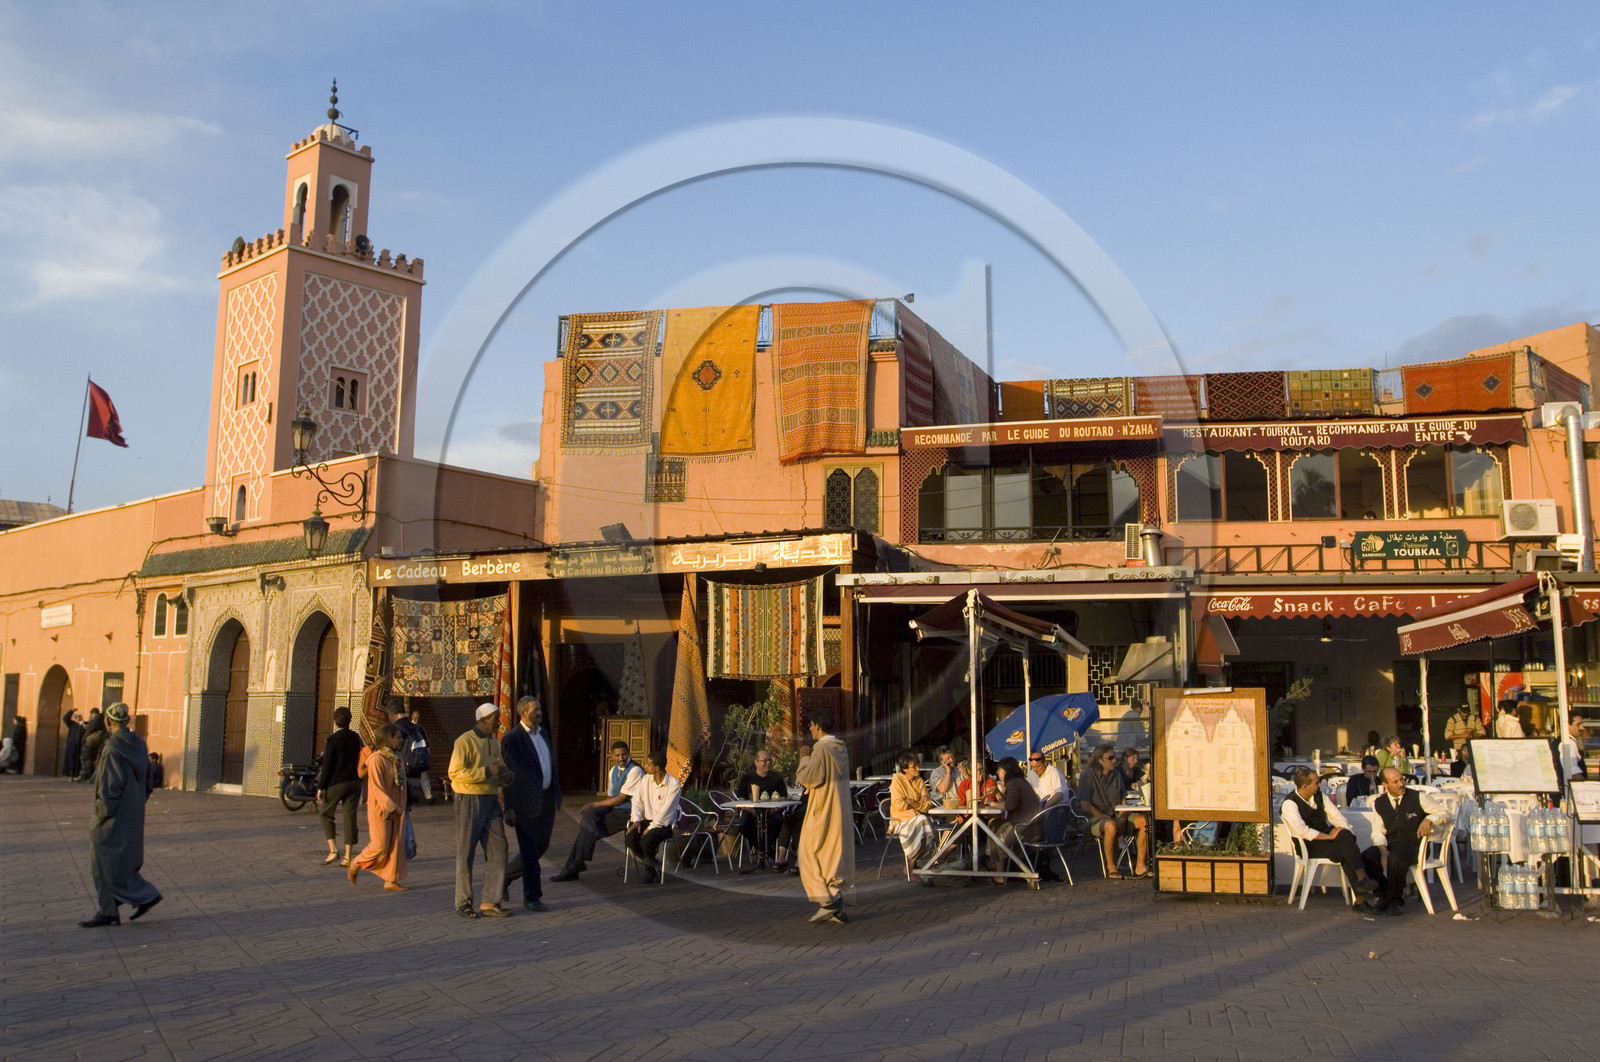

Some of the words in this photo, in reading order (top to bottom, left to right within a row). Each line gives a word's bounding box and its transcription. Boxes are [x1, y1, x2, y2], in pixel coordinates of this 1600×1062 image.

[982, 431, 998, 442] PAR
[1007, 429, 1020, 440] LE
[1023, 428, 1050, 440] GUIDE
[1059, 427, 1071, 438] DU
[1073, 426, 1114, 438] ROUTARD
[1260, 426, 1303, 437] TOUBKAL
[1390, 423, 1409, 433] PAR
[1414, 422, 1426, 432] LE
[1429, 420, 1457, 432] GUIDE
[1464, 420, 1477, 431] DU
[1281, 436, 1331, 447] ROUTARD
[1393, 548, 1441, 557] TOUBKAL
[376, 566, 392, 580] Le
[397, 563, 446, 579] Cadeau
[462, 559, 521, 576] Berbère
[554, 568, 565, 577] Le
[567, 566, 603, 576] Cadeau
[1272, 597, 1334, 613] Snack
[1041, 737, 1068, 754] ORANGINA
